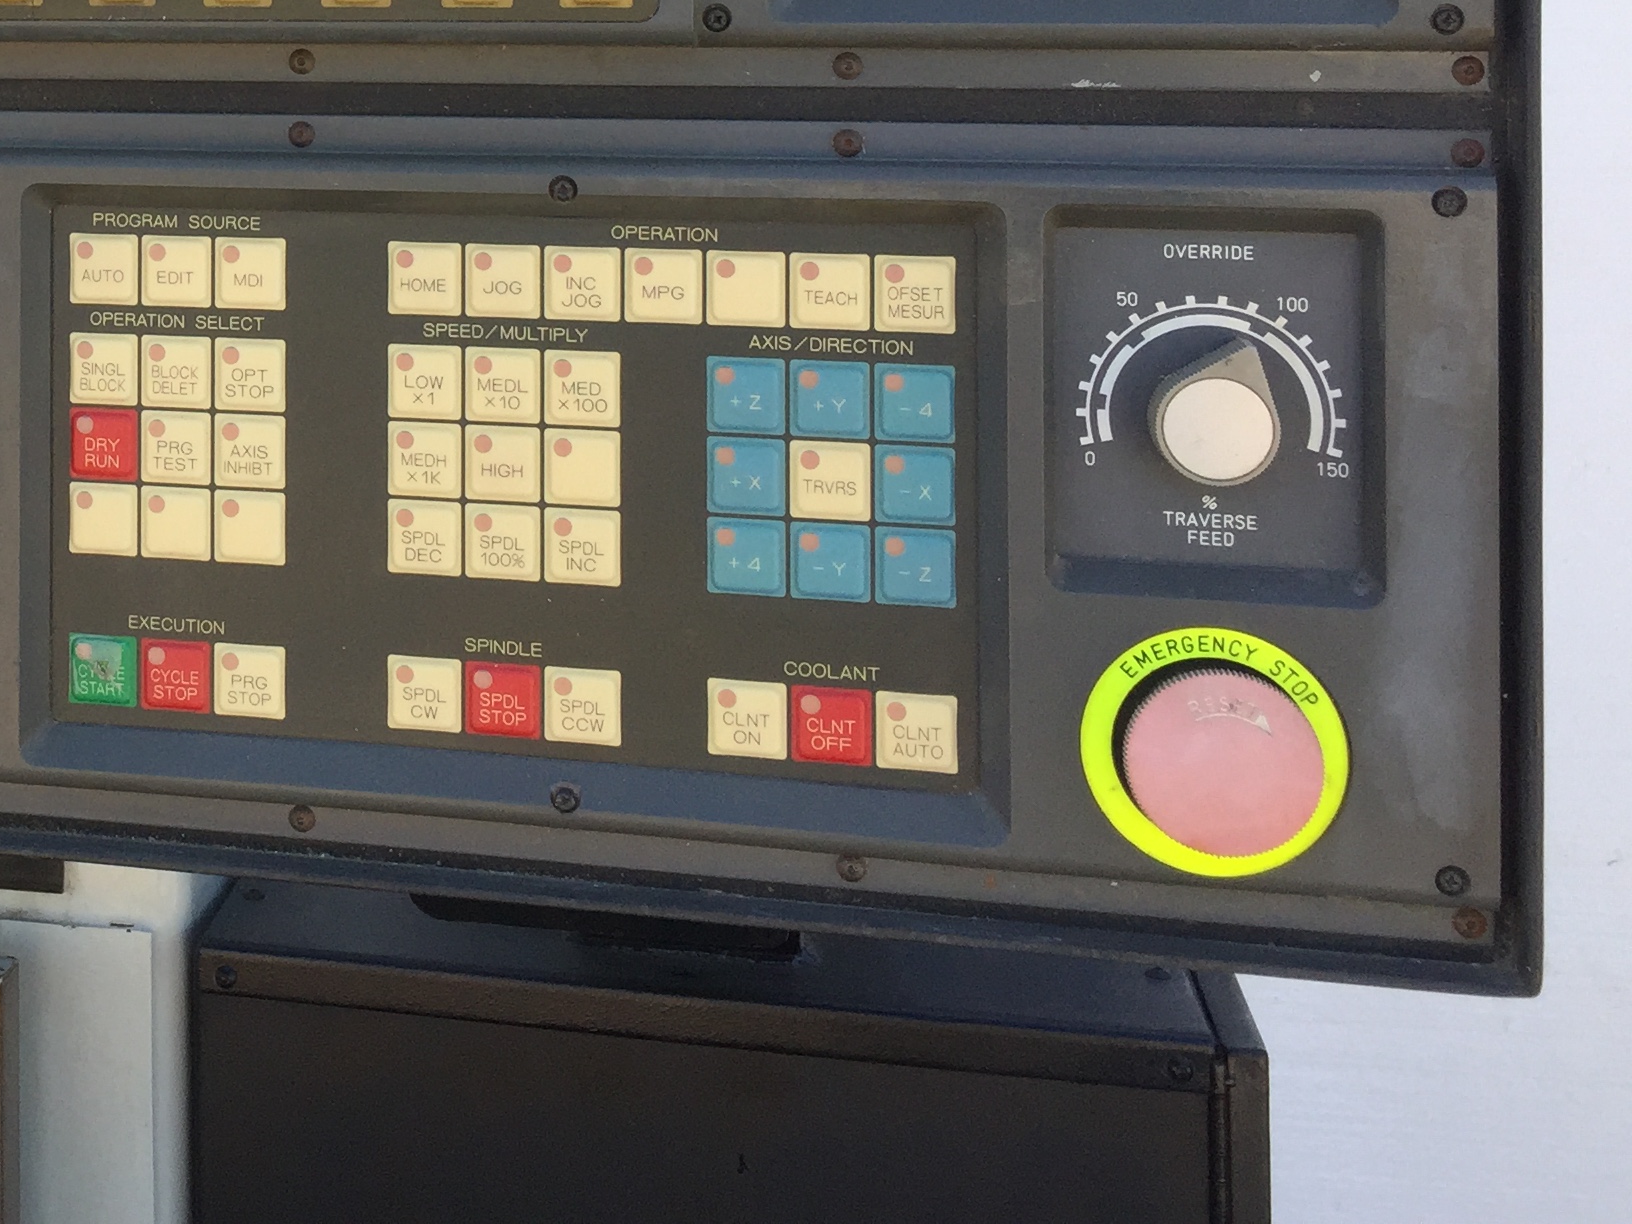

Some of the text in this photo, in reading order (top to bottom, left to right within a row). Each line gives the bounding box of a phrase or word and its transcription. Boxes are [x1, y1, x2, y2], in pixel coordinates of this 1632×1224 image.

[91, 212, 261, 232] PROGRAM SOURCE
[611, 225, 719, 244] OPERATION
[1162, 243, 1255, 261] OVERRIDE
[81, 268, 125, 284] AUTO
[156, 270, 194, 285] EDIT
[233, 273, 264, 288] MDI
[564, 276, 597, 291] INC
[399, 277, 447, 293] HOME
[482, 280, 523, 296] JOG
[641, 284, 686, 301] MPG
[561, 293, 603, 309] JOG
[803, 289, 859, 306] TEACH
[886, 286, 944, 303] OFSET
[1115, 290, 1139, 308] 50
[887, 303, 946, 320] MESUR
[1276, 296, 1310, 314] 100
[89, 311, 266, 332] OPERATION SELECT
[422, 322, 589, 344] SPEED/MULTIPLY
[748, 334, 915, 357] AXIS/DIRECTION
[80, 361, 127, 377] SINGL
[152, 364, 200, 380] BLOCK
[230, 367, 269, 384] OPT
[79, 377, 126, 393] BLOCK
[151, 380, 199, 396] DELET
[403, 374, 445, 390] LOW
[476, 377, 529, 394] MEDL
[560, 381, 602, 396] MED
[224, 384, 275, 399] STOP
[83, 437, 121, 453] DRY
[156, 440, 194, 456] PRG
[229, 444, 270, 459] AXIS
[83, 453, 120, 469] RUN
[152, 456, 199, 472] TEST
[400, 452, 447, 468] MEDH
[1084, 450, 1096, 467] 0
[222, 460, 274, 477] INHIBT
[480, 462, 525, 479] HIGH
[1316, 461, 1350, 479] 150
[802, 478, 858, 496] TRVRS
[1200, 493, 1219, 511] %
[1162, 509, 1260, 531] TRAVERSE
[400, 530, 447, 547] SPDL
[478, 534, 526, 552] SPDL
[1186, 530, 1236, 548] FEED
[404, 548, 443, 564] DEC
[557, 539, 605, 556] SPDL
[479, 552, 526, 569] 100%
[565, 557, 597, 573] INC
[127, 614, 227, 636] EXECUTION
[464, 637, 544, 658] SPINDLE
[150, 669, 200, 685] CYCLE
[782, 660, 881, 682] COOLANT
[1119, 634, 1320, 707] EMERGENCY STOP
[230, 673, 269, 690] PRG
[153, 685, 199, 701] STOP
[227, 691, 273, 707] STOP
[402, 686, 447, 704] SPDL
[479, 692, 525, 710] SPDL
[410, 704, 439, 720] CW
[559, 698, 606, 716] SPDL
[479, 709, 527, 726] STOP
[561, 716, 605, 733] CCW
[721, 711, 770, 728] CLNT
[806, 717, 856, 735] CLNT
[733, 730, 761, 746] ON
[892, 724, 942, 742] CLNT
[810, 735, 853, 752] OFF
[892, 743, 945, 760] AUTO
